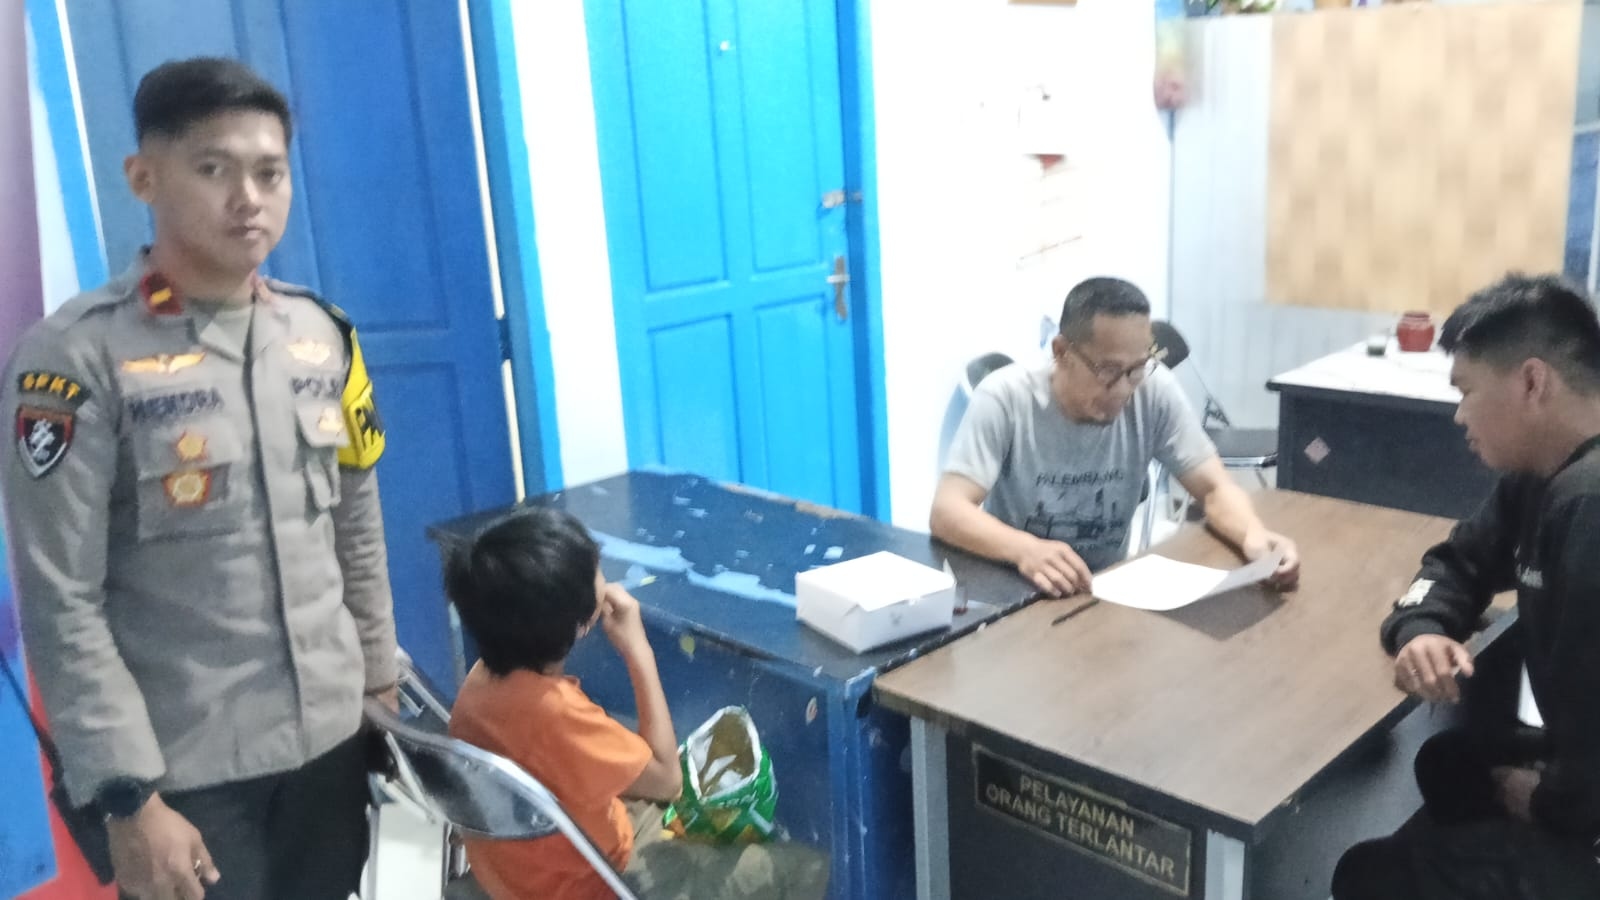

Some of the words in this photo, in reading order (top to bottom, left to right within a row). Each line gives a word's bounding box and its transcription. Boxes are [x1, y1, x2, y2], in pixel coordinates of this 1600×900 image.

[1035, 469, 1124, 486] PALEMBANG
[985, 783, 1051, 826] ORANG
[1056, 811, 1175, 880] TERLANTAR
[1019, 774, 1135, 839] PELAYANAN
